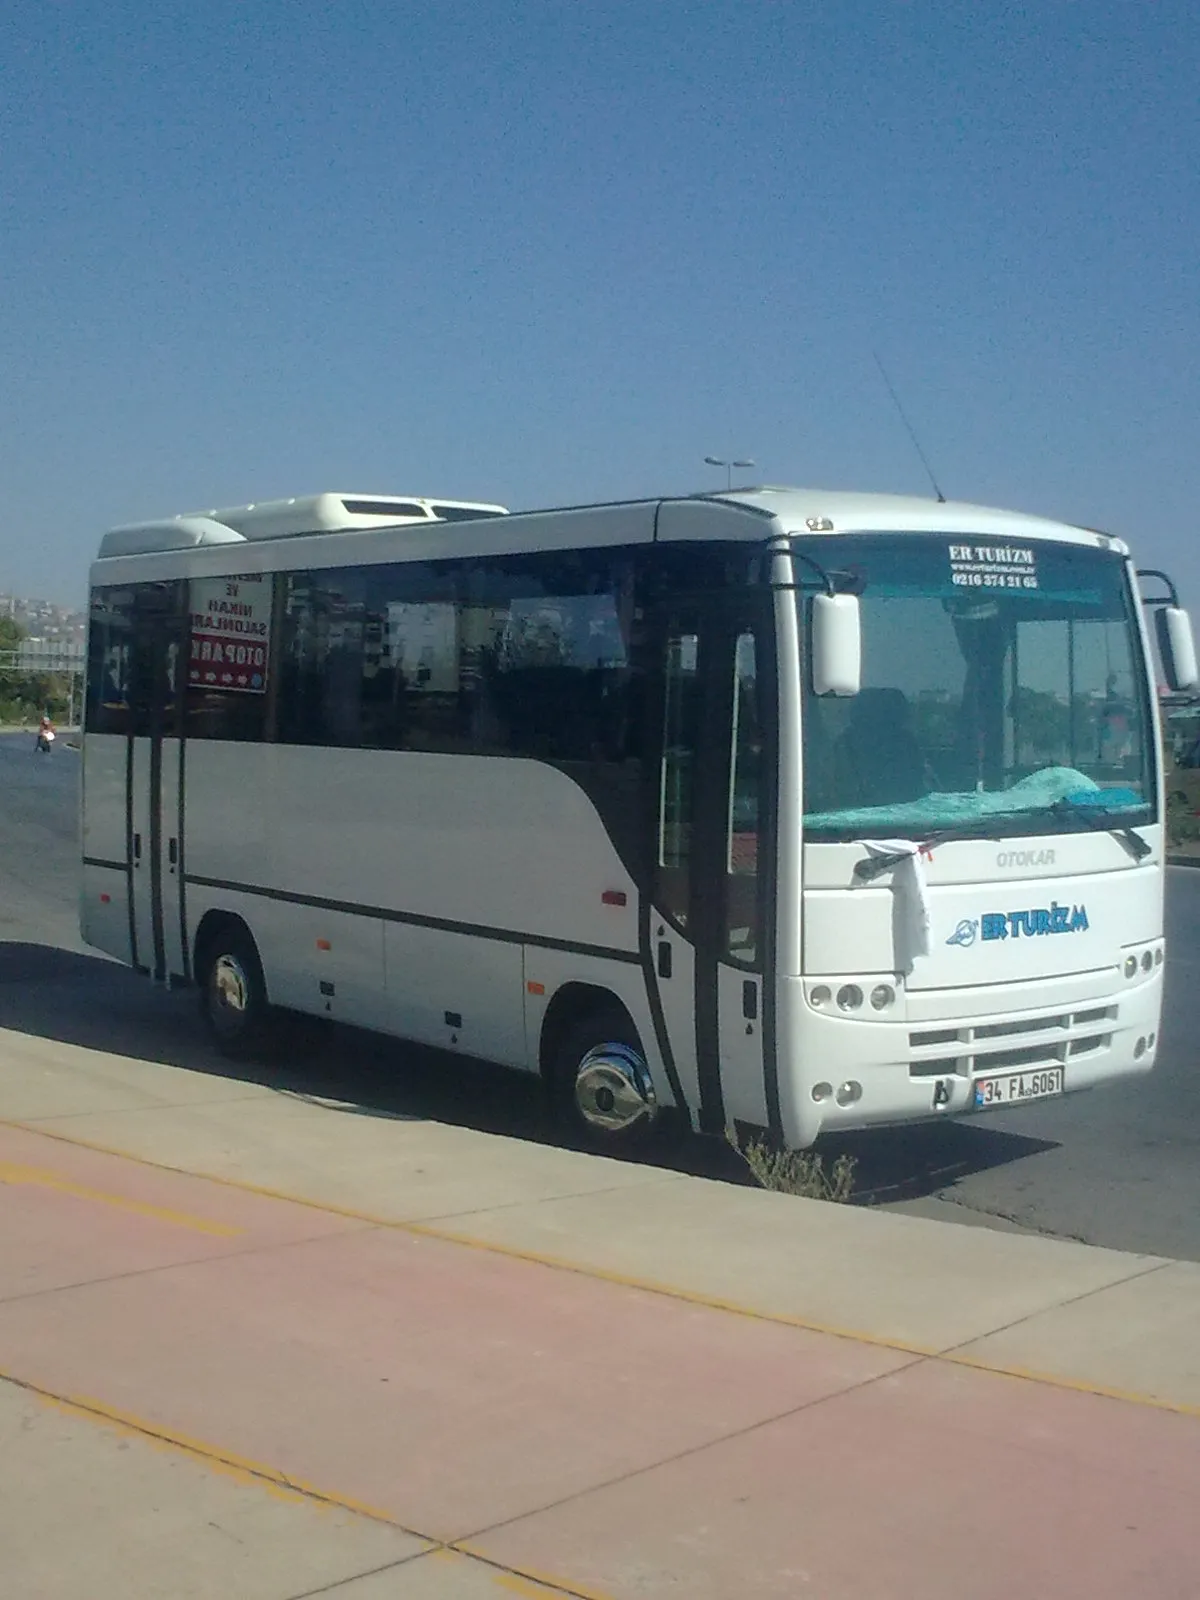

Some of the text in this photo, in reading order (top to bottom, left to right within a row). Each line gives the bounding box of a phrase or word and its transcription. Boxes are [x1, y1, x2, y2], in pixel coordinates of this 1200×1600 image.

[949, 545, 1033, 564] ER TURİZM
[952, 573, 982, 586] 0216
[1007, 575, 1021, 588] 21
[996, 849, 1056, 868] OTOKAR
[985, 1070, 1060, 1102] 34 FA 6061
